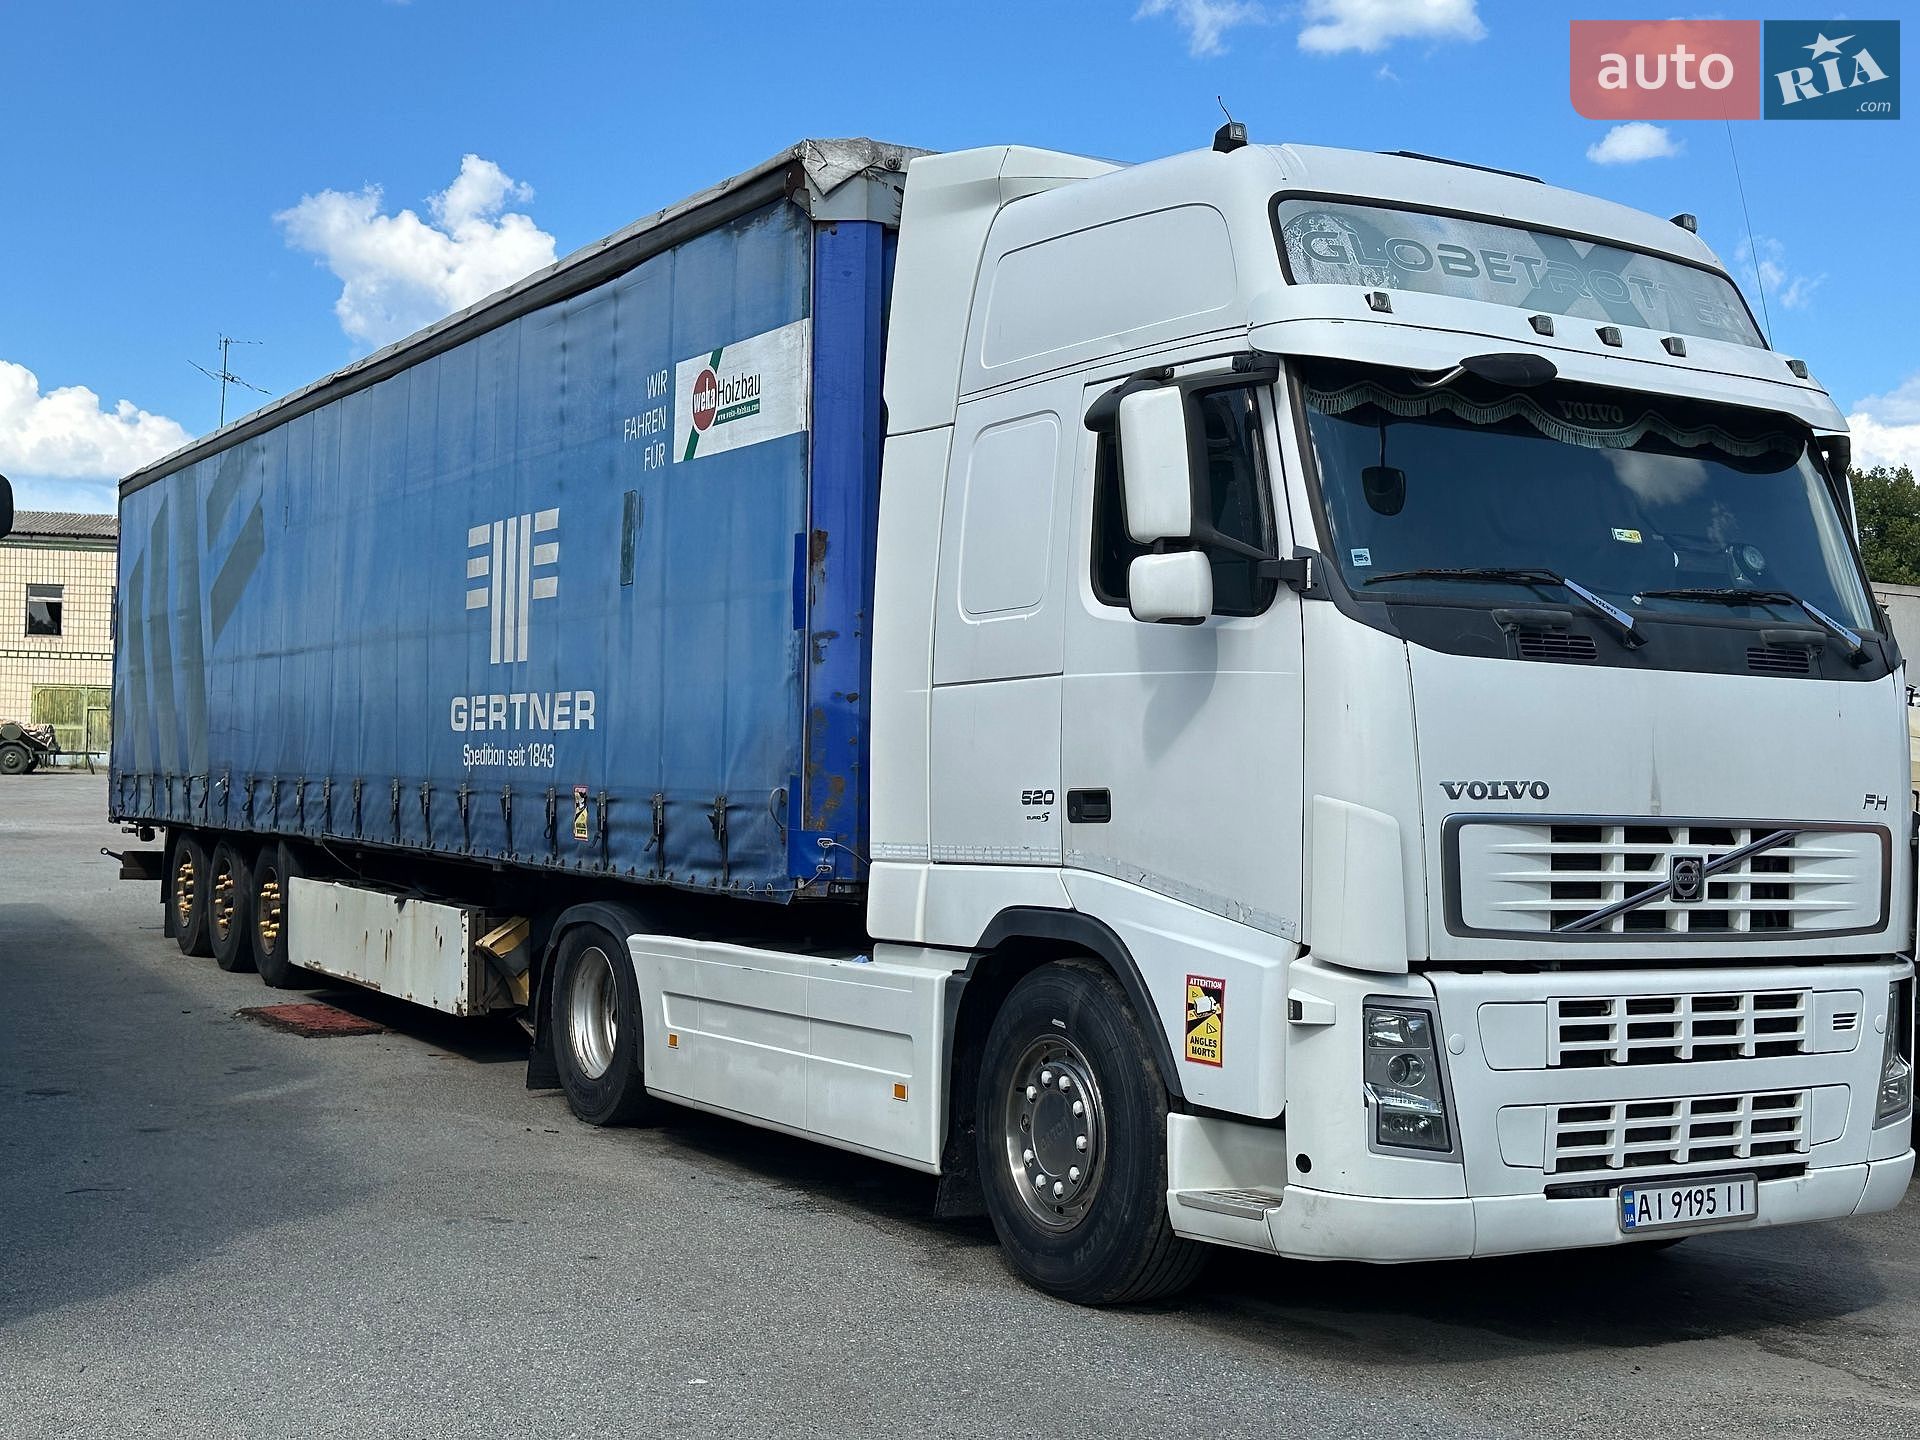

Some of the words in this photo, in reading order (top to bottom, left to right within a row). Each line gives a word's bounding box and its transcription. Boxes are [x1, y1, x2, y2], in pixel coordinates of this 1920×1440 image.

[646, 369, 668, 399] WIR
[694, 378, 716, 413] weka
[717, 373, 760, 406] Holzbau
[1556, 400, 1624, 423] VOLVO
[624, 405, 667, 443] FAHREN
[644, 439, 666, 471] FÜR
[451, 690, 596, 732] GERTNER
[463, 743, 505, 772] Spedition
[507, 744, 526, 767] seit
[528, 743, 555, 768] 1843
[1021, 789, 1055, 805] 520
[1439, 780, 1550, 800] VOLVO
[1862, 793, 1888, 811] FH
[1189, 977, 1223, 990] ATTENTION
[1190, 1035, 1218, 1049] ANGLES
[1191, 1045, 1216, 1059] MORTS
[1637, 1192, 1663, 1222] AI
[1671, 1187, 1717, 1219] 9195
[1625, 1213, 1635, 1223] UA
